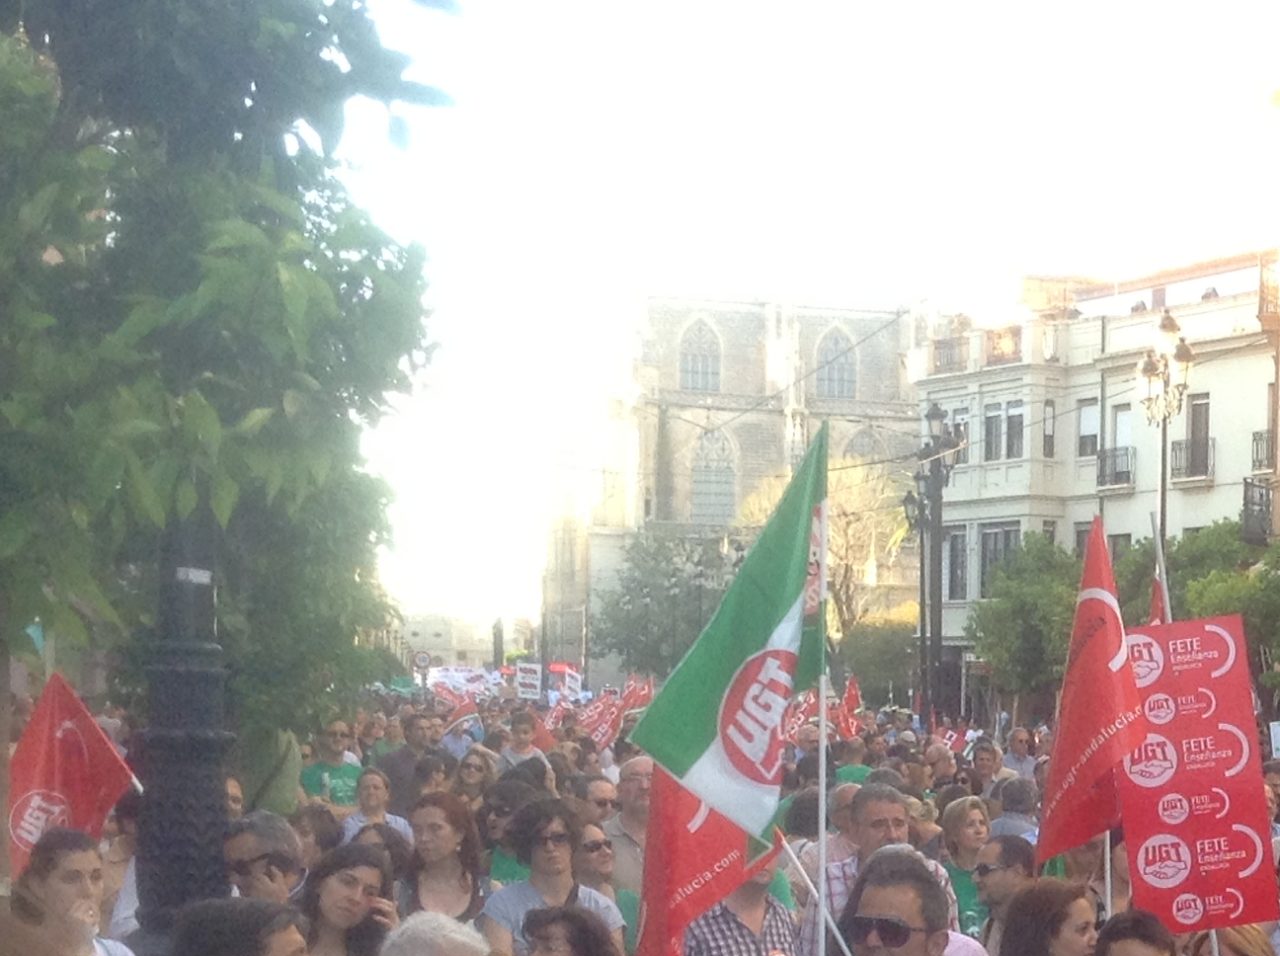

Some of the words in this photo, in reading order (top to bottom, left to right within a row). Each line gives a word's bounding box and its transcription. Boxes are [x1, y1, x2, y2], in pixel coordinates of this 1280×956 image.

[1129, 641, 1154, 662] GT
[1168, 636, 1201, 654] FETE
[727, 657, 795, 763] UGT
[1149, 698, 1170, 712] UGT
[1130, 741, 1170, 763] UGT
[1182, 735, 1216, 752] FETE
[1162, 798, 1185, 812] UGT
[17, 794, 66, 845] UGT
[1196, 836, 1230, 853] FETE
[1144, 842, 1184, 867] UGT
[1176, 898, 1199, 913] UGT
